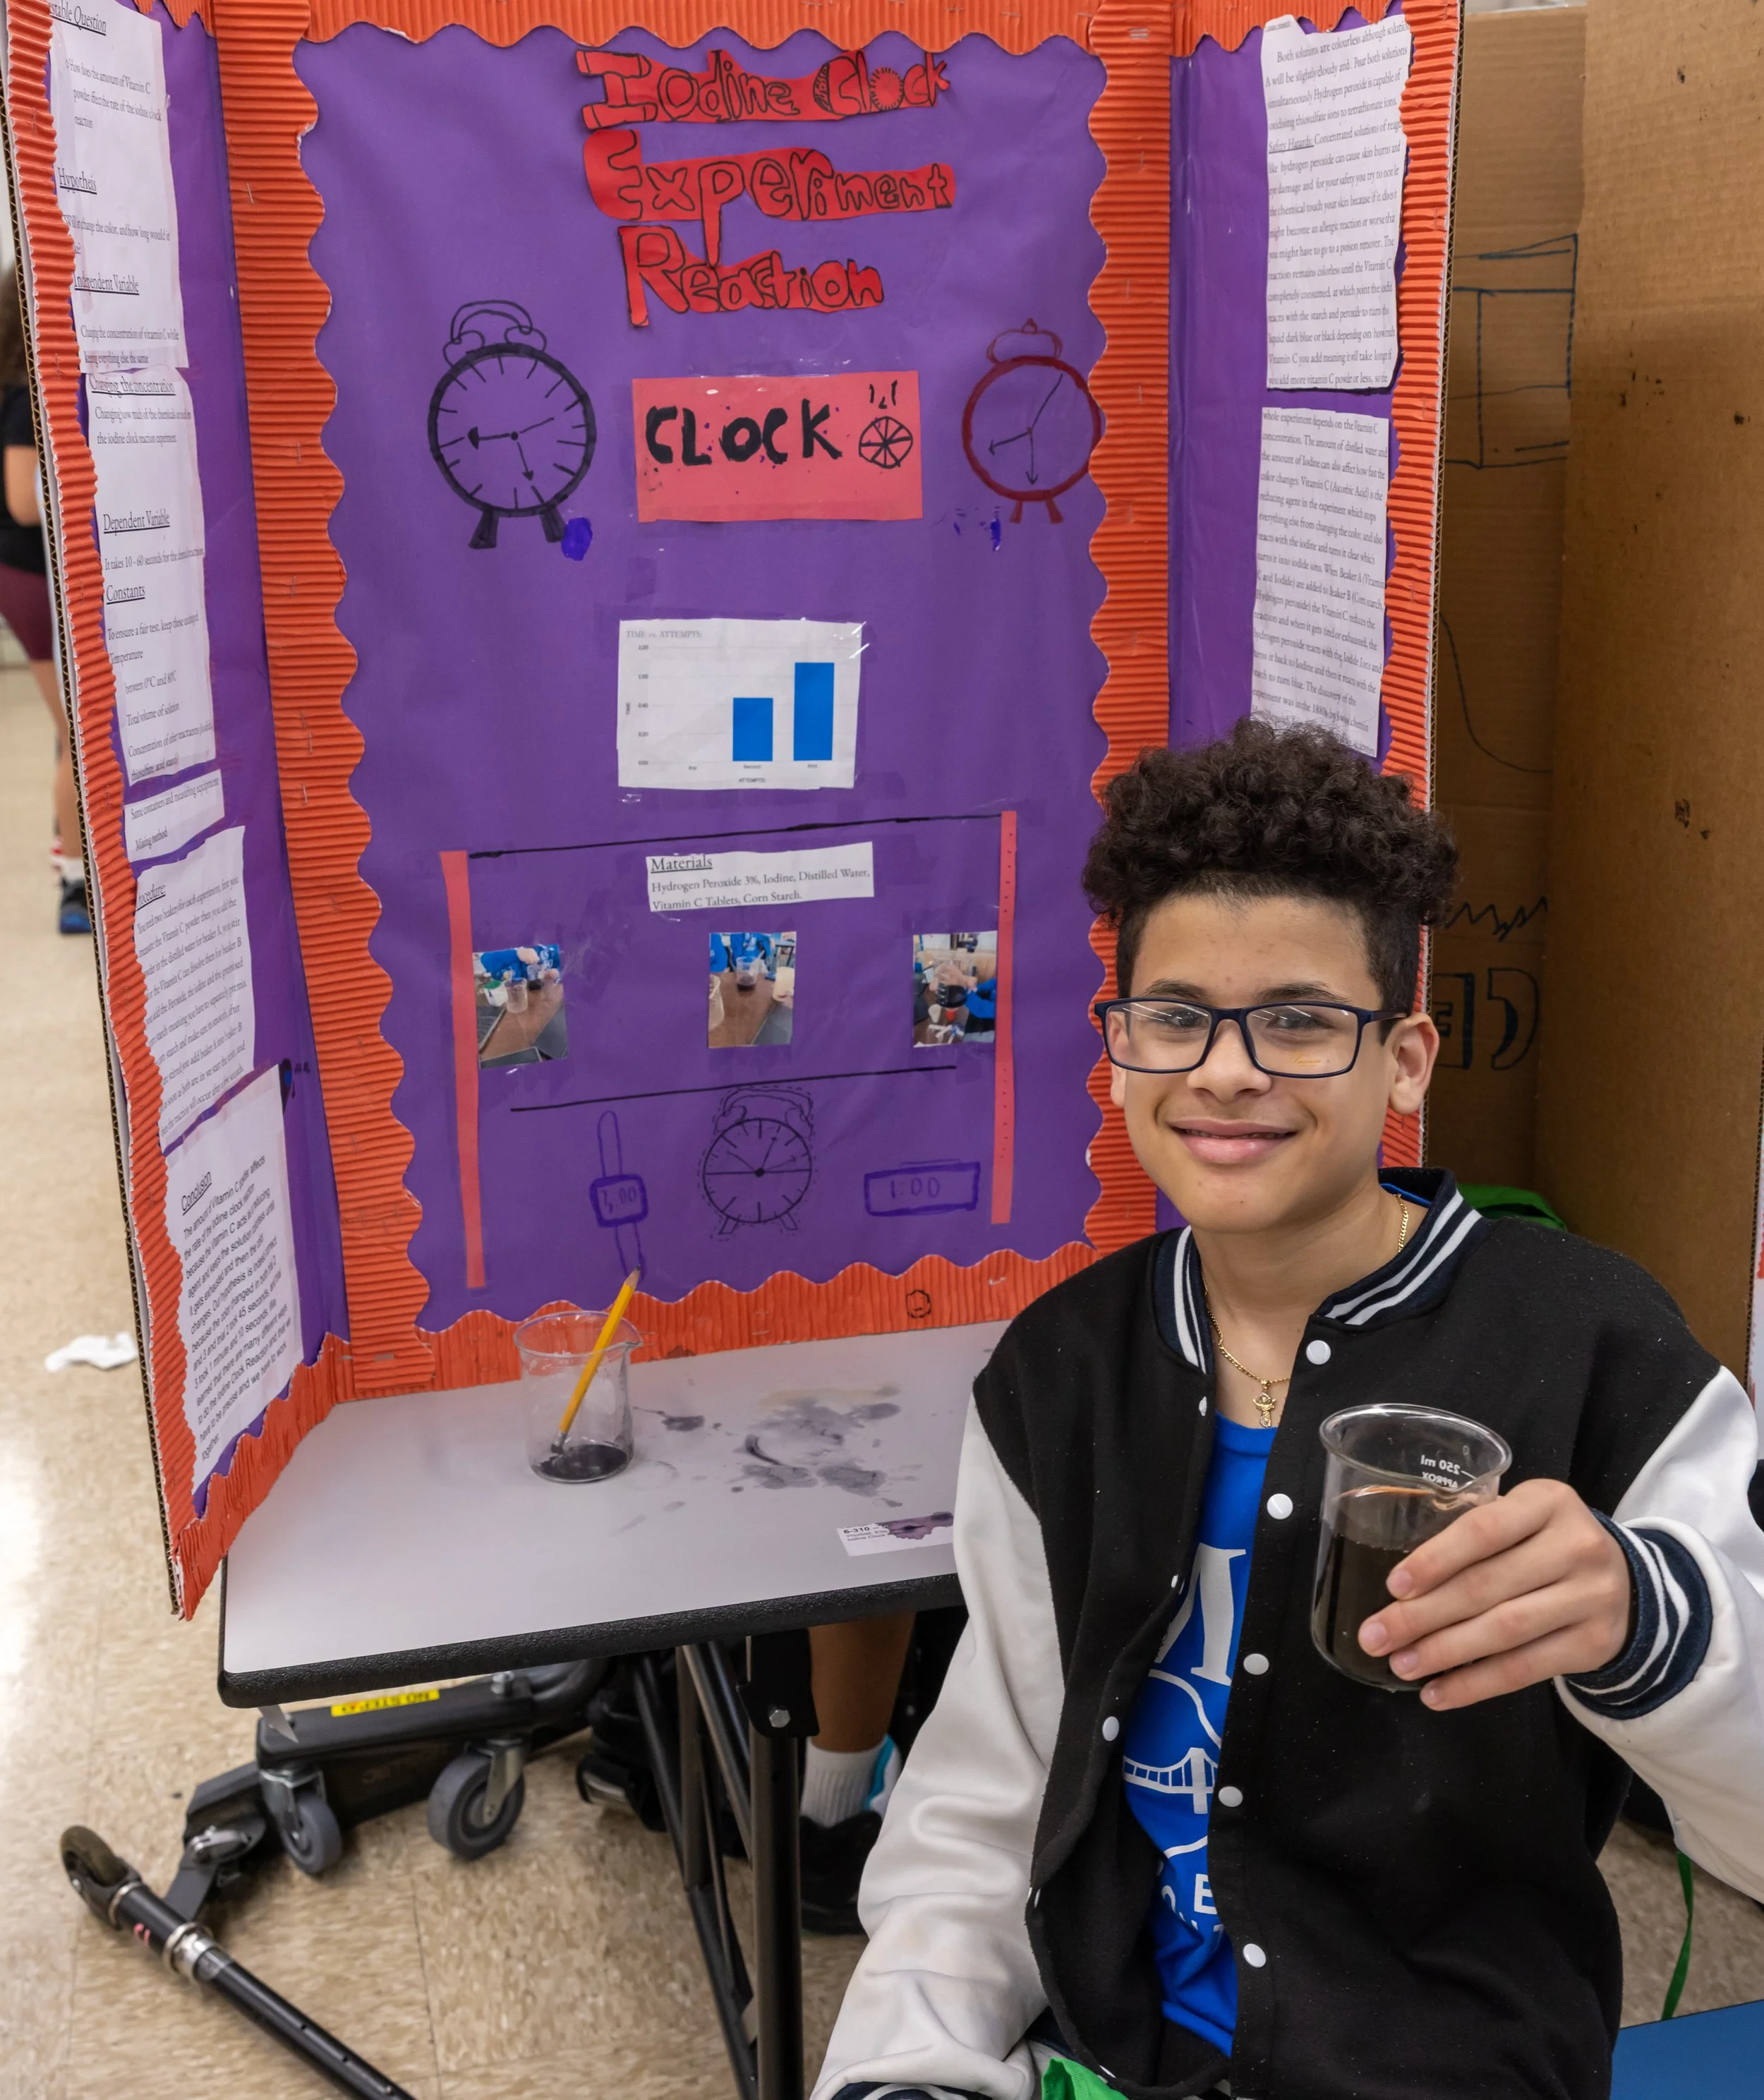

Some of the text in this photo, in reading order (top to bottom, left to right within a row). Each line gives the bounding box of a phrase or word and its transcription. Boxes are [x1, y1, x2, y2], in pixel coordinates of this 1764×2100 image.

[74, 6, 107, 32] Question
[1277, 30, 1386, 63] Both are colourless although
[1354, 46, 1407, 68] Pour both solutions
[1265, 59, 1350, 87] A will be and
[145, 83, 150, 94] C
[576, 50, 950, 131] Iodine Clock
[1314, 86, 1343, 103] Hydrogen
[1344, 78, 1367, 98] peroxide
[1373, 71, 1394, 89] capable
[1395, 68, 1401, 80] of
[1327, 109, 1339, 120] ions
[1341, 108, 1346, 117] to
[1269, 143, 1286, 153] Safety
[1315, 128, 1353, 145] Concentrated
[1354, 121, 1379, 136] solutions
[1380, 119, 1387, 132] of
[1281, 140, 1401, 175] hydrogen peroxide can cause skin burns and
[1278, 183, 1301, 195] damage
[1303, 179, 1313, 191] and
[1316, 179, 1324, 188] for
[1325, 177, 1339, 192] your
[1340, 173, 1355, 187] safety
[1355, 171, 1366, 186] you
[583, 130, 953, 269] Experiment
[1278, 193, 1370, 216] chemical touch your skin because
[1384, 235, 1394, 246] The
[1279, 244, 1312, 261] might have
[1293, 269, 1316, 278] remains
[1365, 258, 1392, 272] Vitamin C
[114, 274, 139, 292] Variable
[617, 226, 884, 327] Reaction
[121, 375, 133, 392] the
[1263, 411, 1312, 427] whole experiment
[1344, 418, 1378, 434] the C
[97, 433, 107, 443] the
[108, 433, 125, 443] iodine
[646, 398, 843, 466] CLOCK
[1262, 432, 1363, 453] concentration. The amount of distilled
[1271, 453, 1294, 464] amount
[1295, 454, 1302, 465] of
[1303, 455, 1319, 467] Iodine
[1331, 460, 1341, 470] also
[1342, 461, 1355, 473] affect
[1356, 464, 1367, 475] how
[1368, 466, 1377, 478] fast
[1301, 476, 1374, 500] Vitamin C Acid) is
[1285, 496, 1317, 509] agent in the
[104, 509, 169, 536] Dependent Variable
[1300, 515, 1315, 529] from
[105, 559, 110, 570] It
[111, 557, 123, 569] takes
[125, 556, 132, 567] 10
[137, 555, 144, 567] 60
[145, 552, 162, 565] seconds
[106, 585, 145, 601] Constants
[108, 629, 115, 640] To
[116, 629, 134, 639] ensure
[651, 854, 713, 871] Materials
[652, 881, 700, 895] Hydrogen
[703, 878, 742, 889] Peroxide
[764, 873, 797, 883] Iodine,
[799, 869, 838, 881] Distilled
[840, 868, 870, 878] Water,
[653, 891, 802, 910] Vitamin C Tablets, Corn Starch.
[179, 922, 183, 933] C
[181, 1171, 212, 1212] Conclusion
[212, 1188, 234, 1208] Vitamin
[234, 1181, 238, 1193] C
[890, 1176, 940, 1199] 1:00
[229, 1201, 243, 1215] clock
[230, 1222, 235, 1233] C
[239, 1289, 269, 1319] 45 seconds
[246, 1309, 268, 1332] seconds
